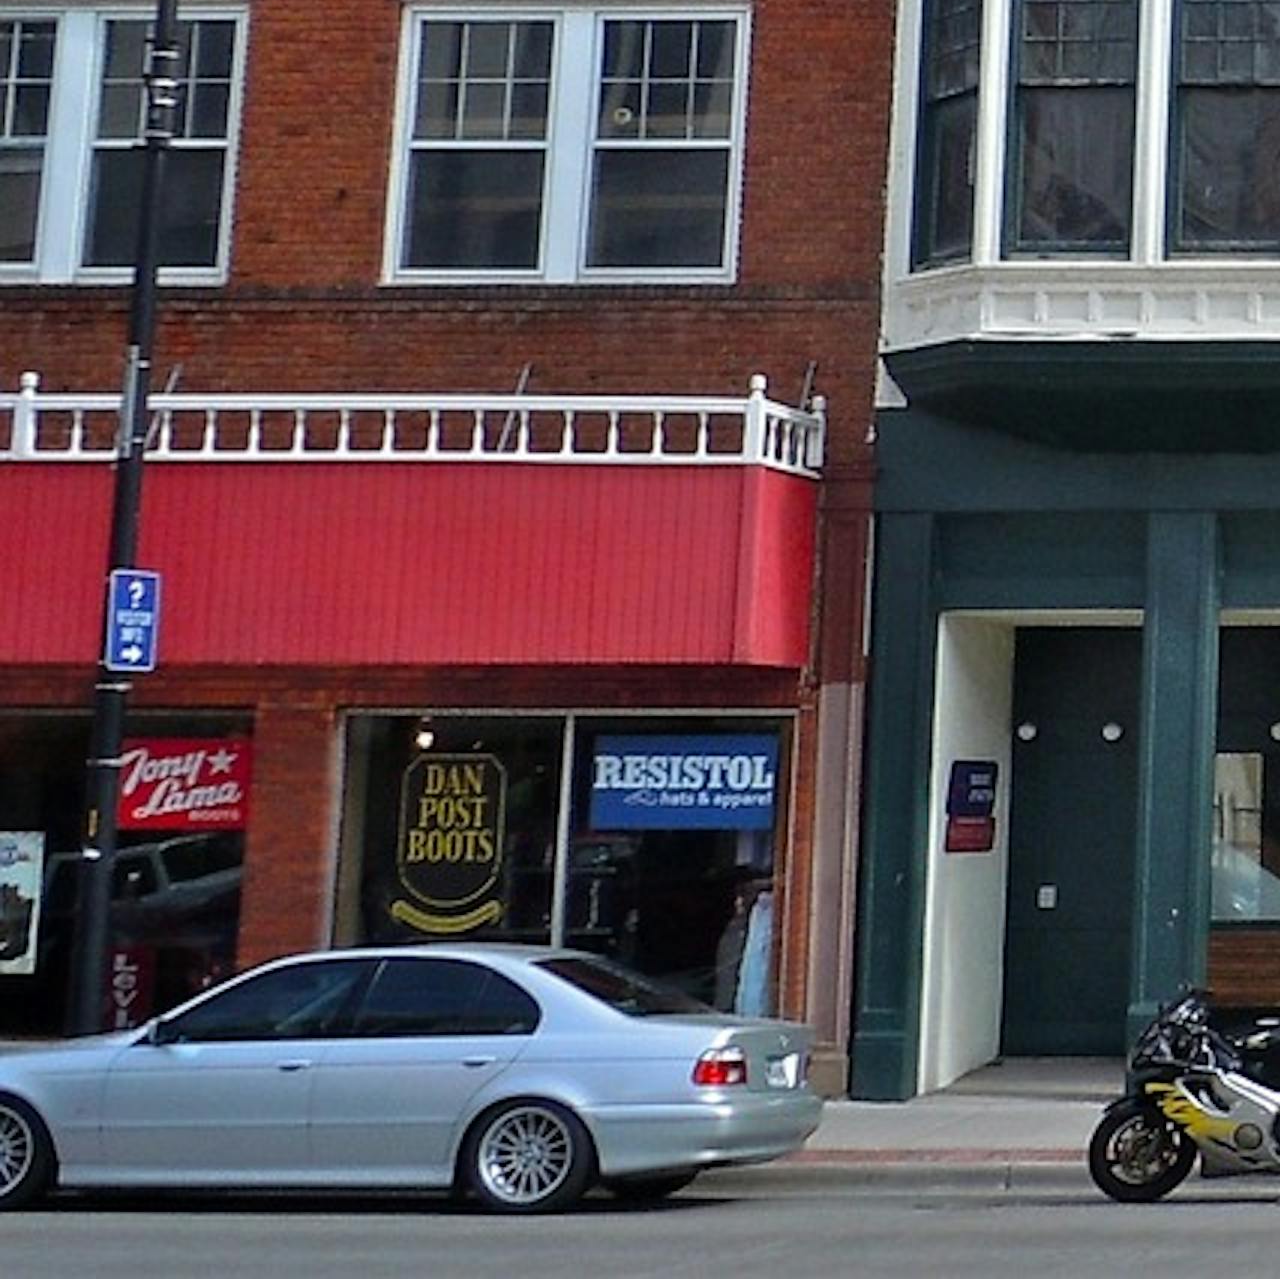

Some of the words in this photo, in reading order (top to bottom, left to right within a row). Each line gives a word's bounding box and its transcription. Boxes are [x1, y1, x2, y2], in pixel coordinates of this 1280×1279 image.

[120, 747, 207, 796] Tony
[424, 763, 484, 795] DAN
[592, 755, 775, 790] RESISTOL
[131, 777, 243, 819] Lama
[418, 797, 487, 828] POST
[659, 791, 695, 806] hats
[712, 791, 773, 809] apparel
[406, 828, 494, 862] BOOTS
